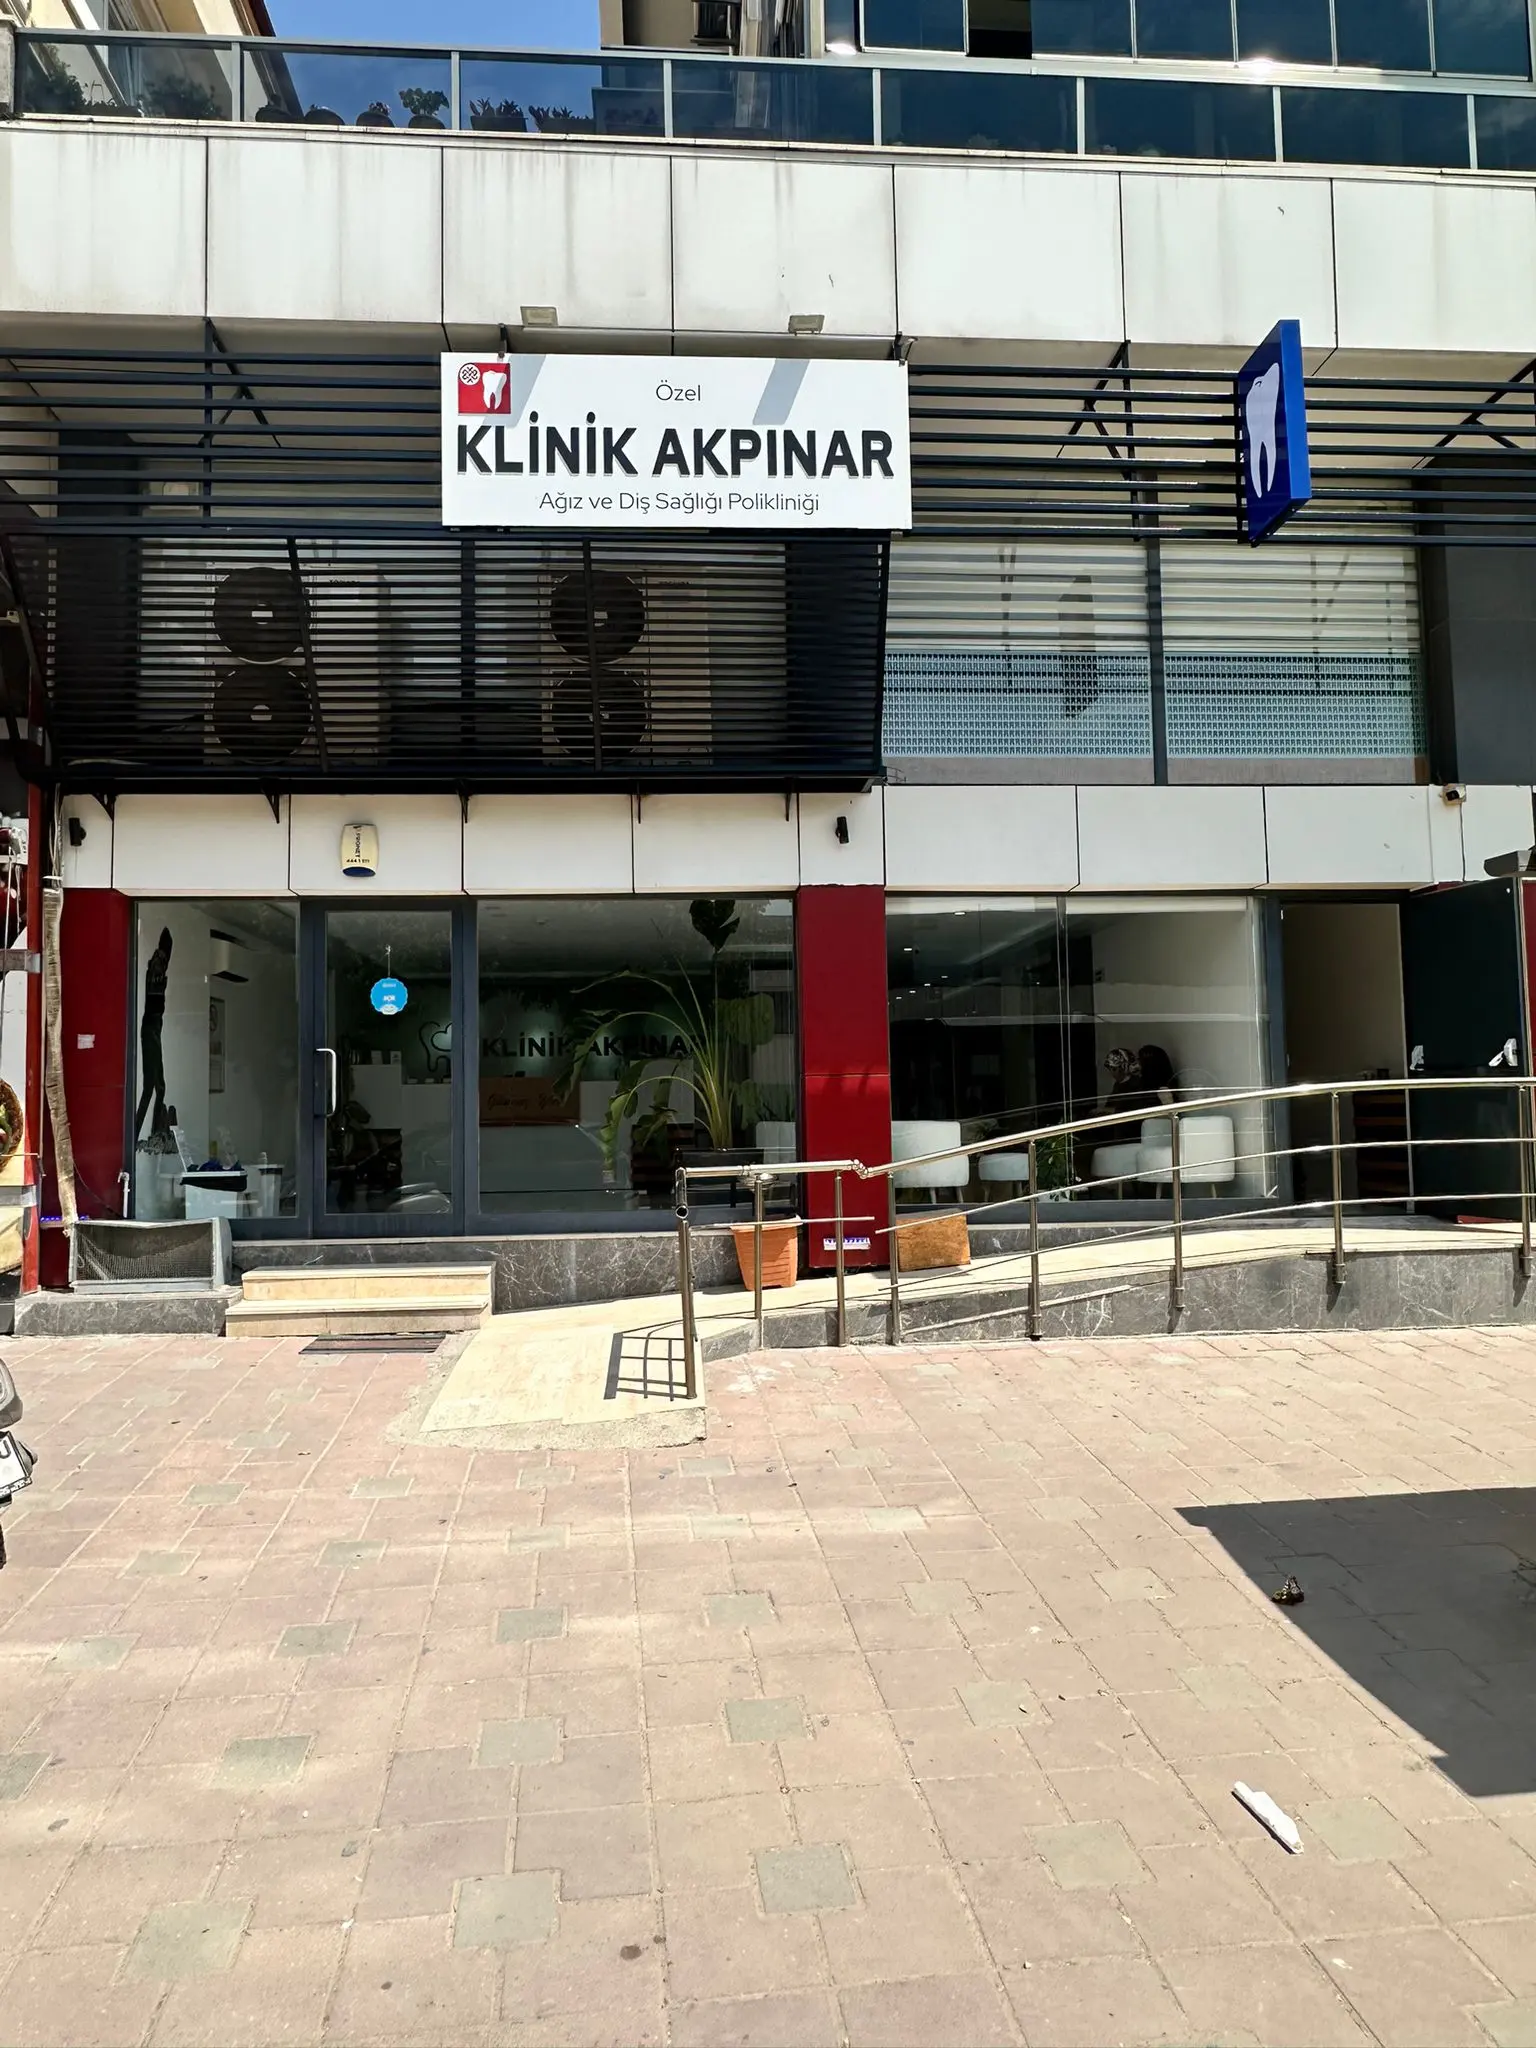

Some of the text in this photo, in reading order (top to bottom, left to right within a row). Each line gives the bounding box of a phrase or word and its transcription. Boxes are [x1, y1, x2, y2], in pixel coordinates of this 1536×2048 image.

[655, 379, 702, 402] Özel
[456, 410, 894, 479] KLİNİK AKPINAR
[539, 491, 820, 516] Ağız ve Diş Sağlığı Polikliniği
